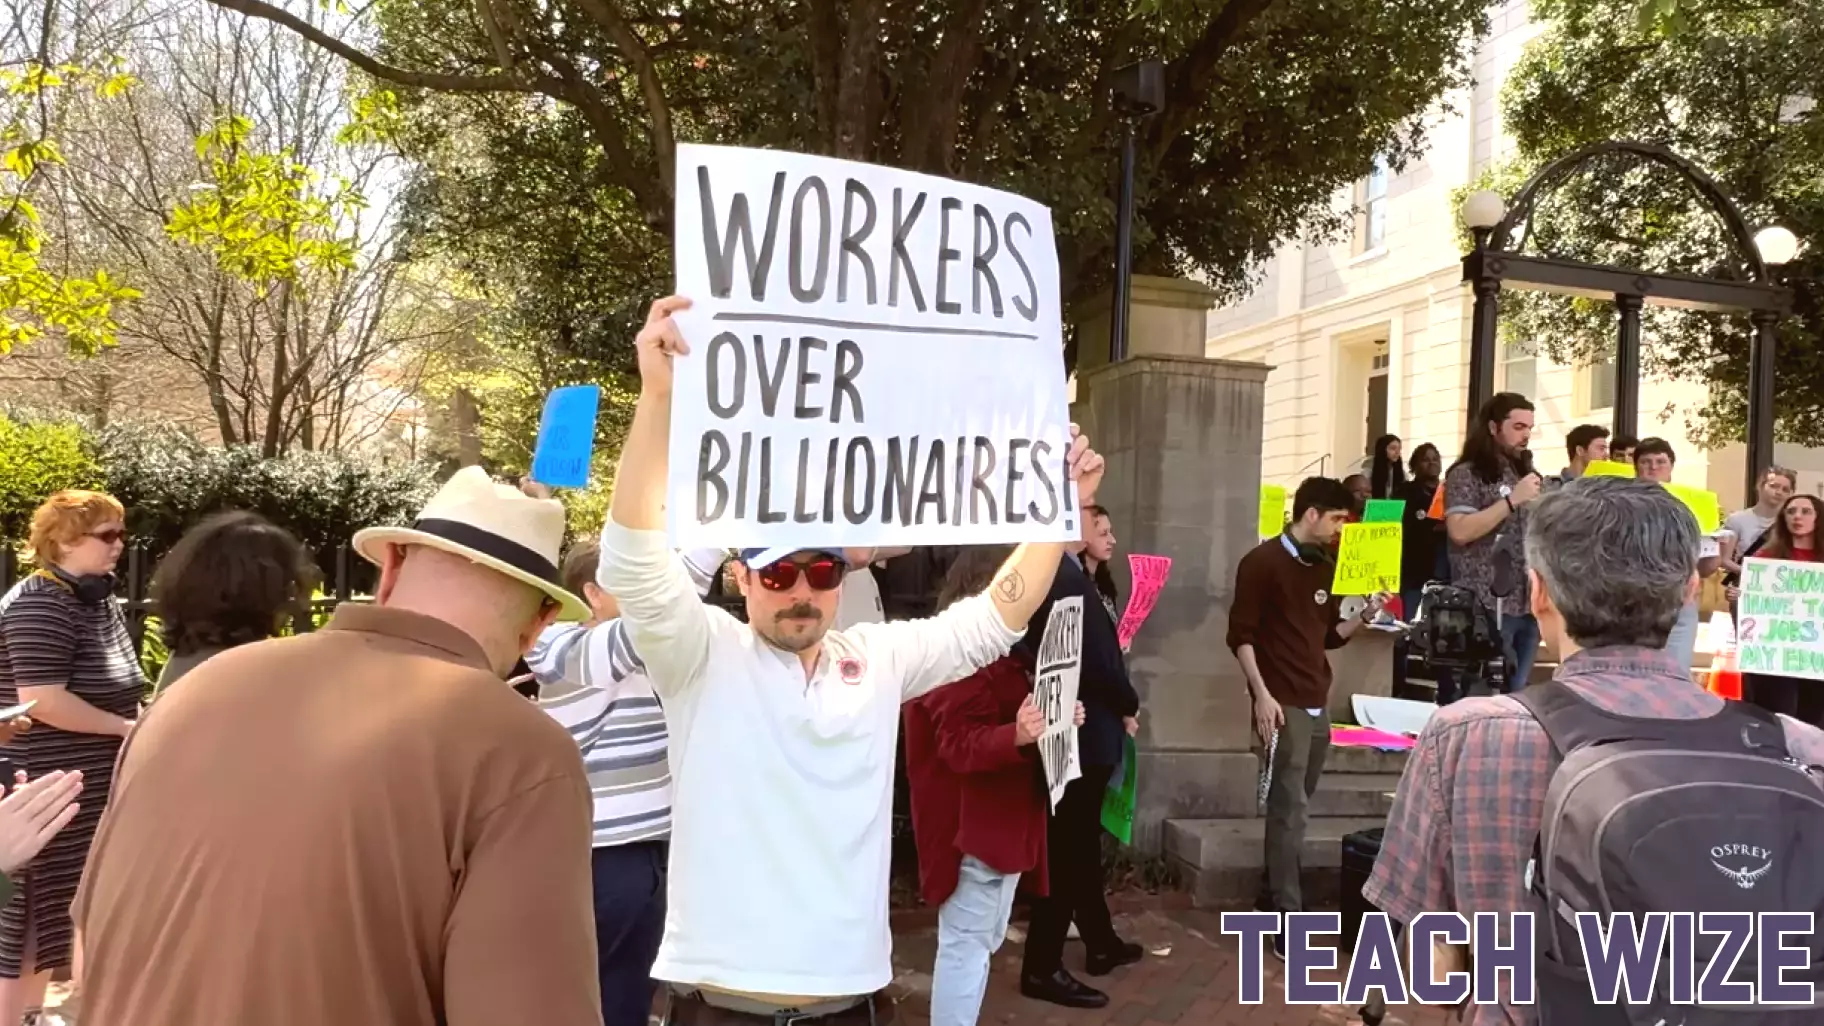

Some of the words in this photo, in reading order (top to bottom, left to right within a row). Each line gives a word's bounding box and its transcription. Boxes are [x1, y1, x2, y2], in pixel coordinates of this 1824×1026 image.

[697, 165, 1038, 322] WORKERS
[706, 331, 864, 424] OVER
[696, 429, 1074, 531] BILLIONAIRES!
[1747, 563, 1768, 591] I
[1740, 617, 1757, 642] 2
[1758, 618, 1819, 643] JOBS
[1739, 645, 1777, 671] MY
[1710, 843, 1772, 859] OSPREY
